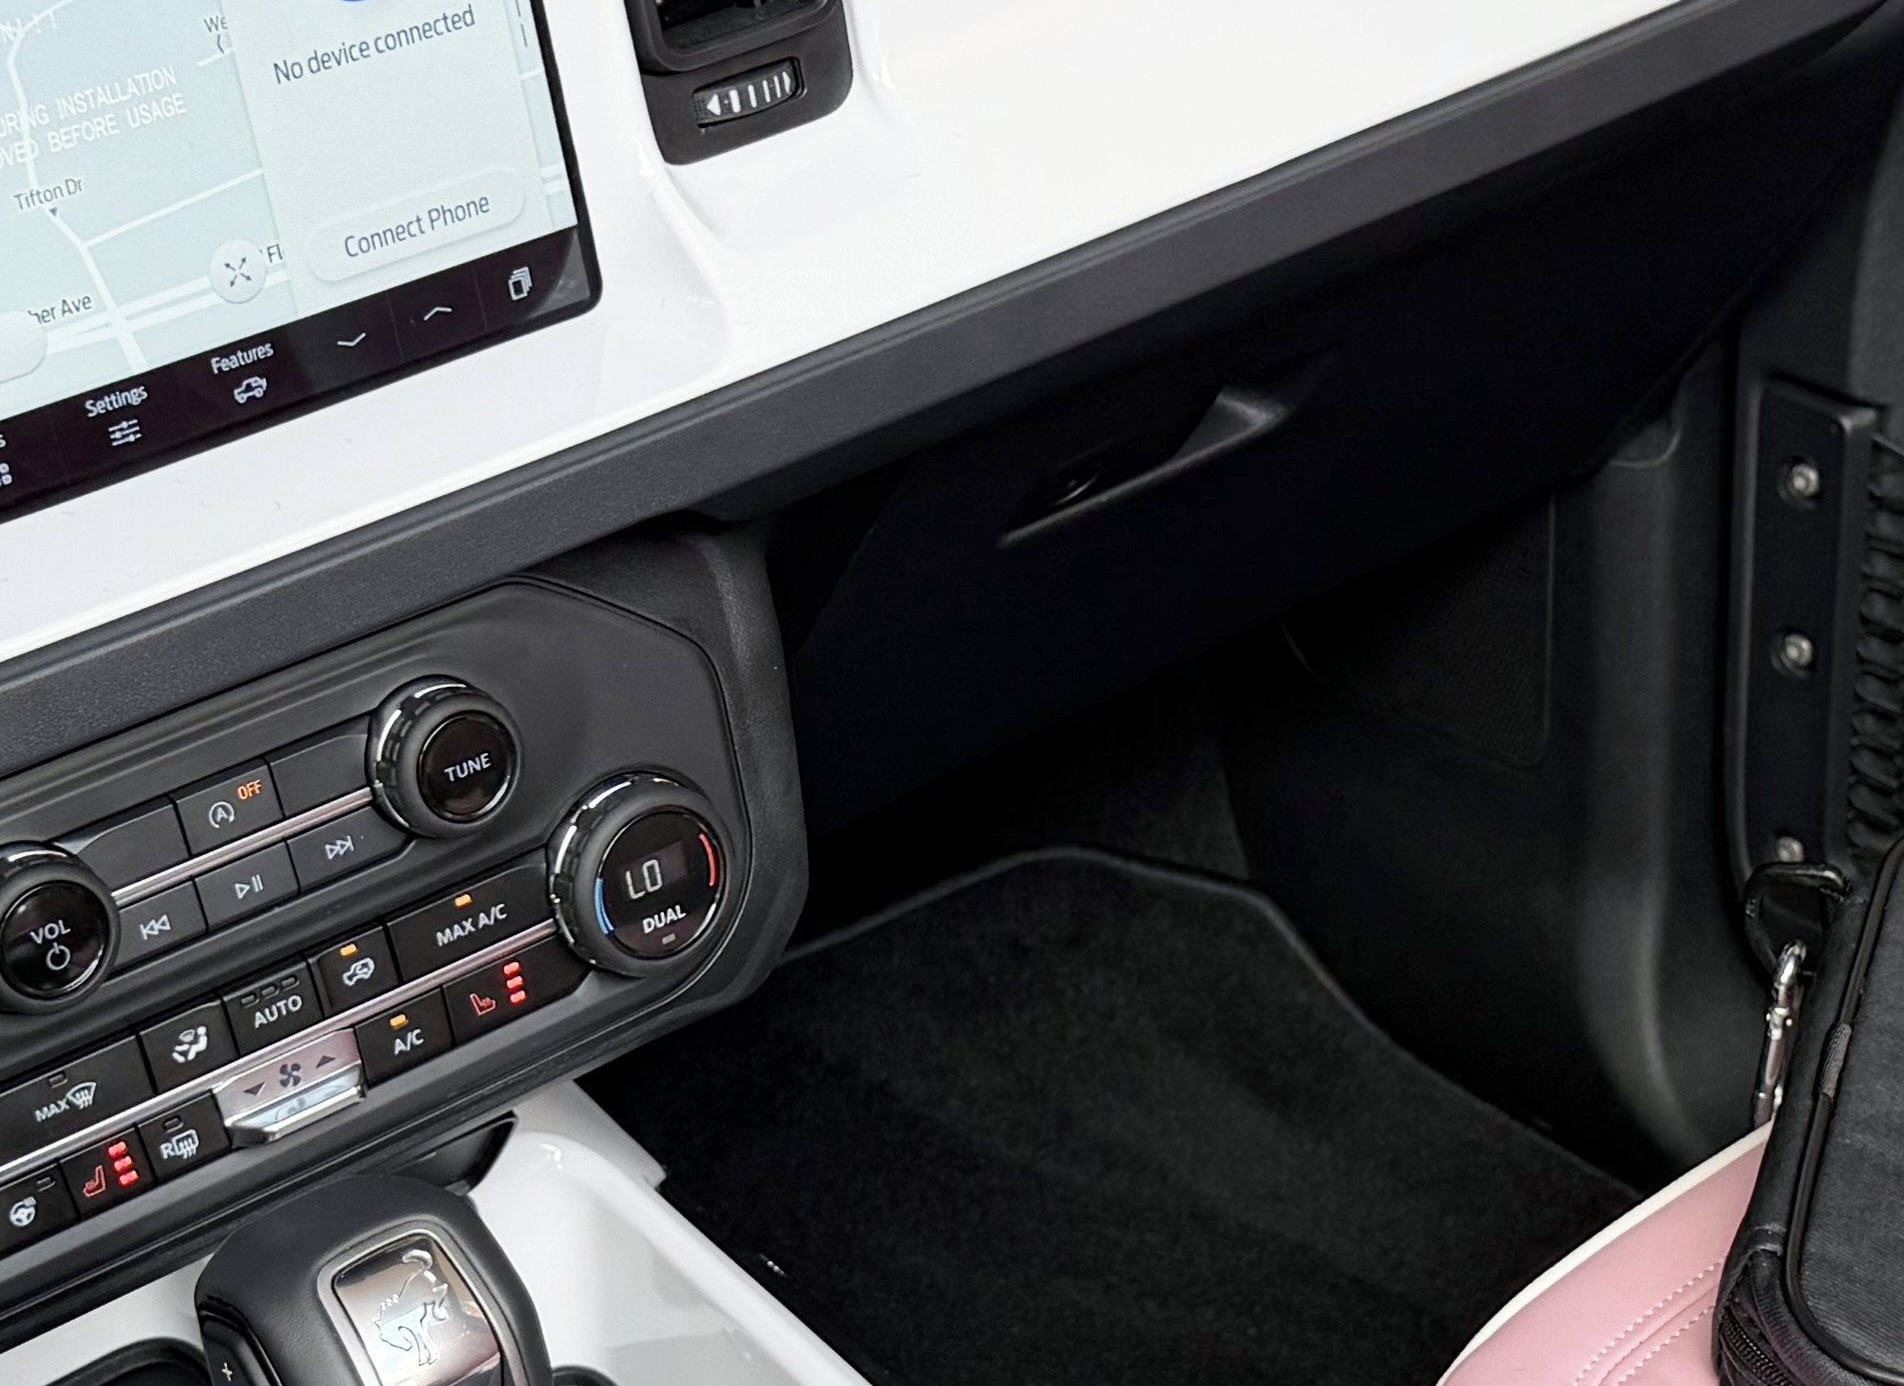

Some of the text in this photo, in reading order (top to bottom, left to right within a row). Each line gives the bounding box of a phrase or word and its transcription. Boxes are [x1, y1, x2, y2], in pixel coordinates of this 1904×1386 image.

[274, 4, 475, 84] No device connected
[56, 65, 177, 119] INSTALLATION
[47, 113, 121, 153] BEFORE
[129, 93, 188, 129] USAGE
[14, 178, 84, 211] Tifton Dr
[345, 196, 490, 257] Connect Phone
[61, 294, 93, 319] Ave
[211, 341, 275, 375] Features
[85, 385, 148, 418] Settings
[445, 752, 492, 784] TUNE
[237, 778, 266, 801] OFF
[30, 919, 72, 945] VOL
[436, 903, 509, 948] MAX A/C
[641, 905, 687, 935] DUAL
[253, 994, 304, 1030] AUTO
[393, 1027, 425, 1056] A/C
[34, 1101, 70, 1122] MAX
